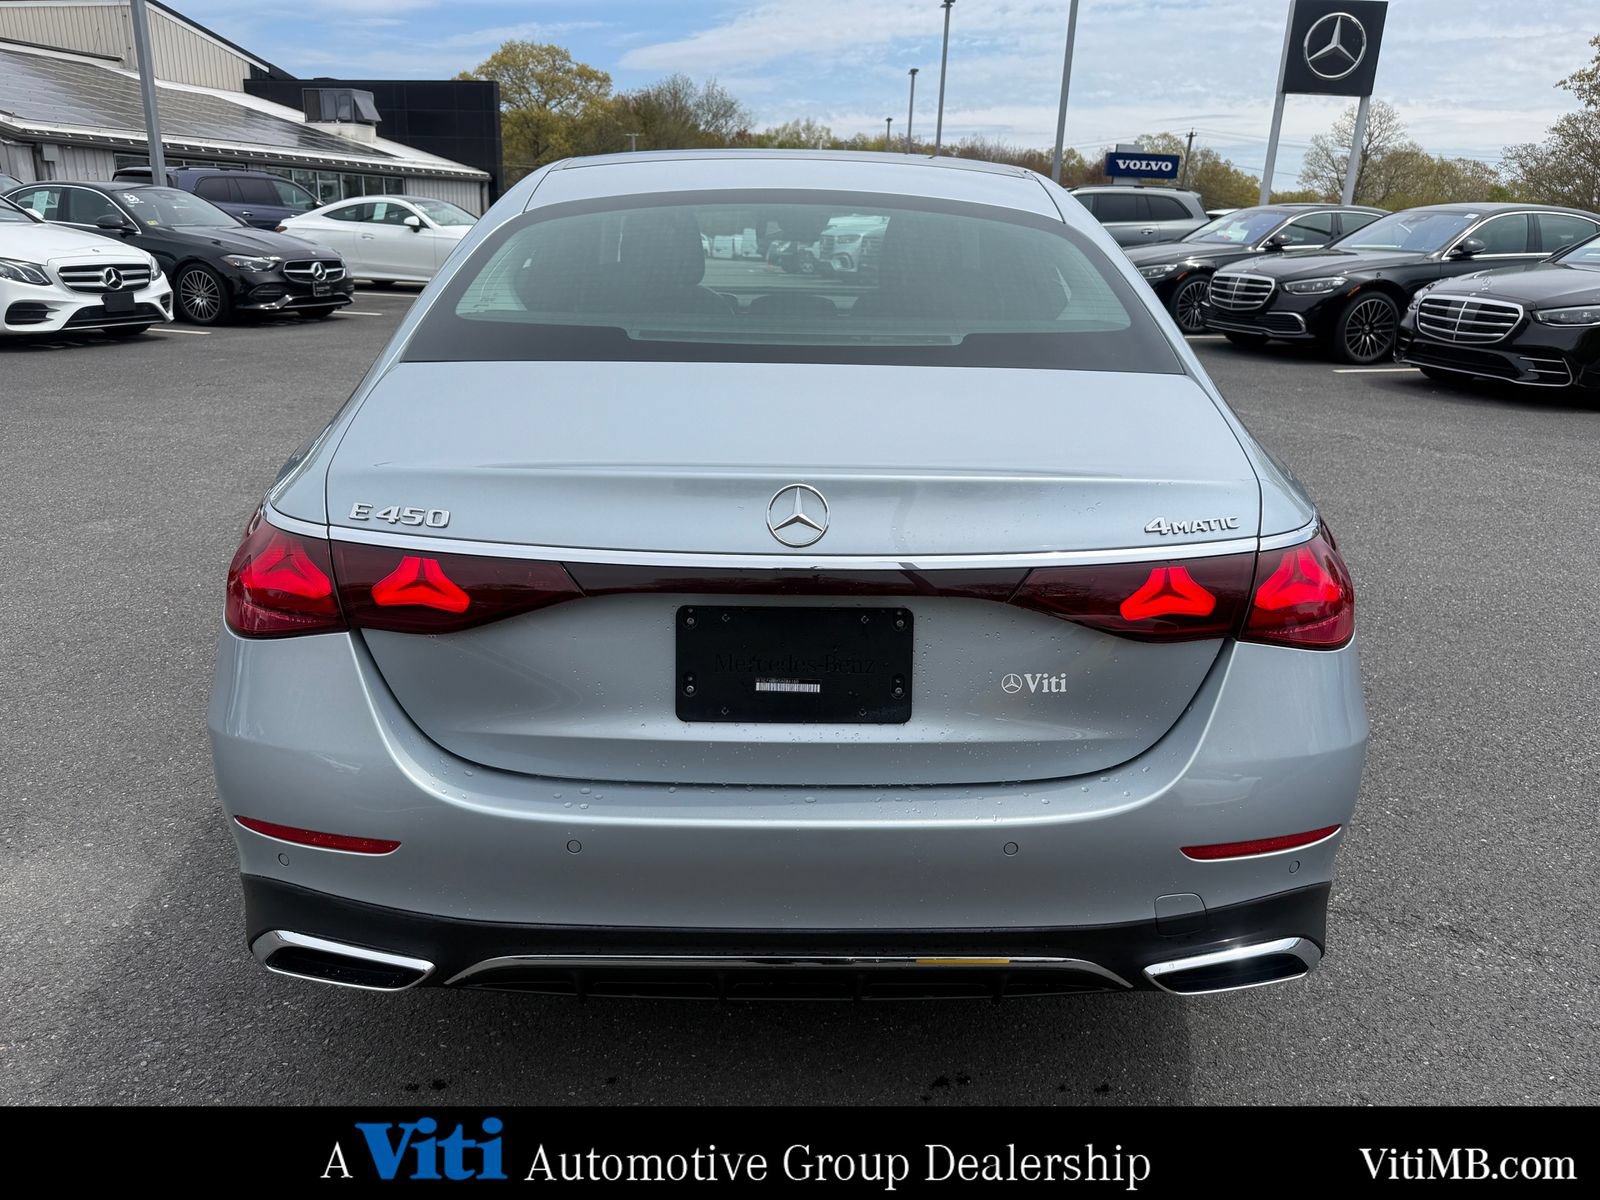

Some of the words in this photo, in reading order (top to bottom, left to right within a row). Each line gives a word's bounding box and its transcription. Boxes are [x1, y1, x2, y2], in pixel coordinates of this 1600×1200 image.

[1116, 160, 1172, 171] VOLVO
[349, 502, 373, 520] E
[375, 505, 451, 528] 450
[1144, 516, 1240, 536] 4MATIC
[714, 653, 876, 674] Mercedes-Benz
[1023, 672, 1067, 694] Viti
